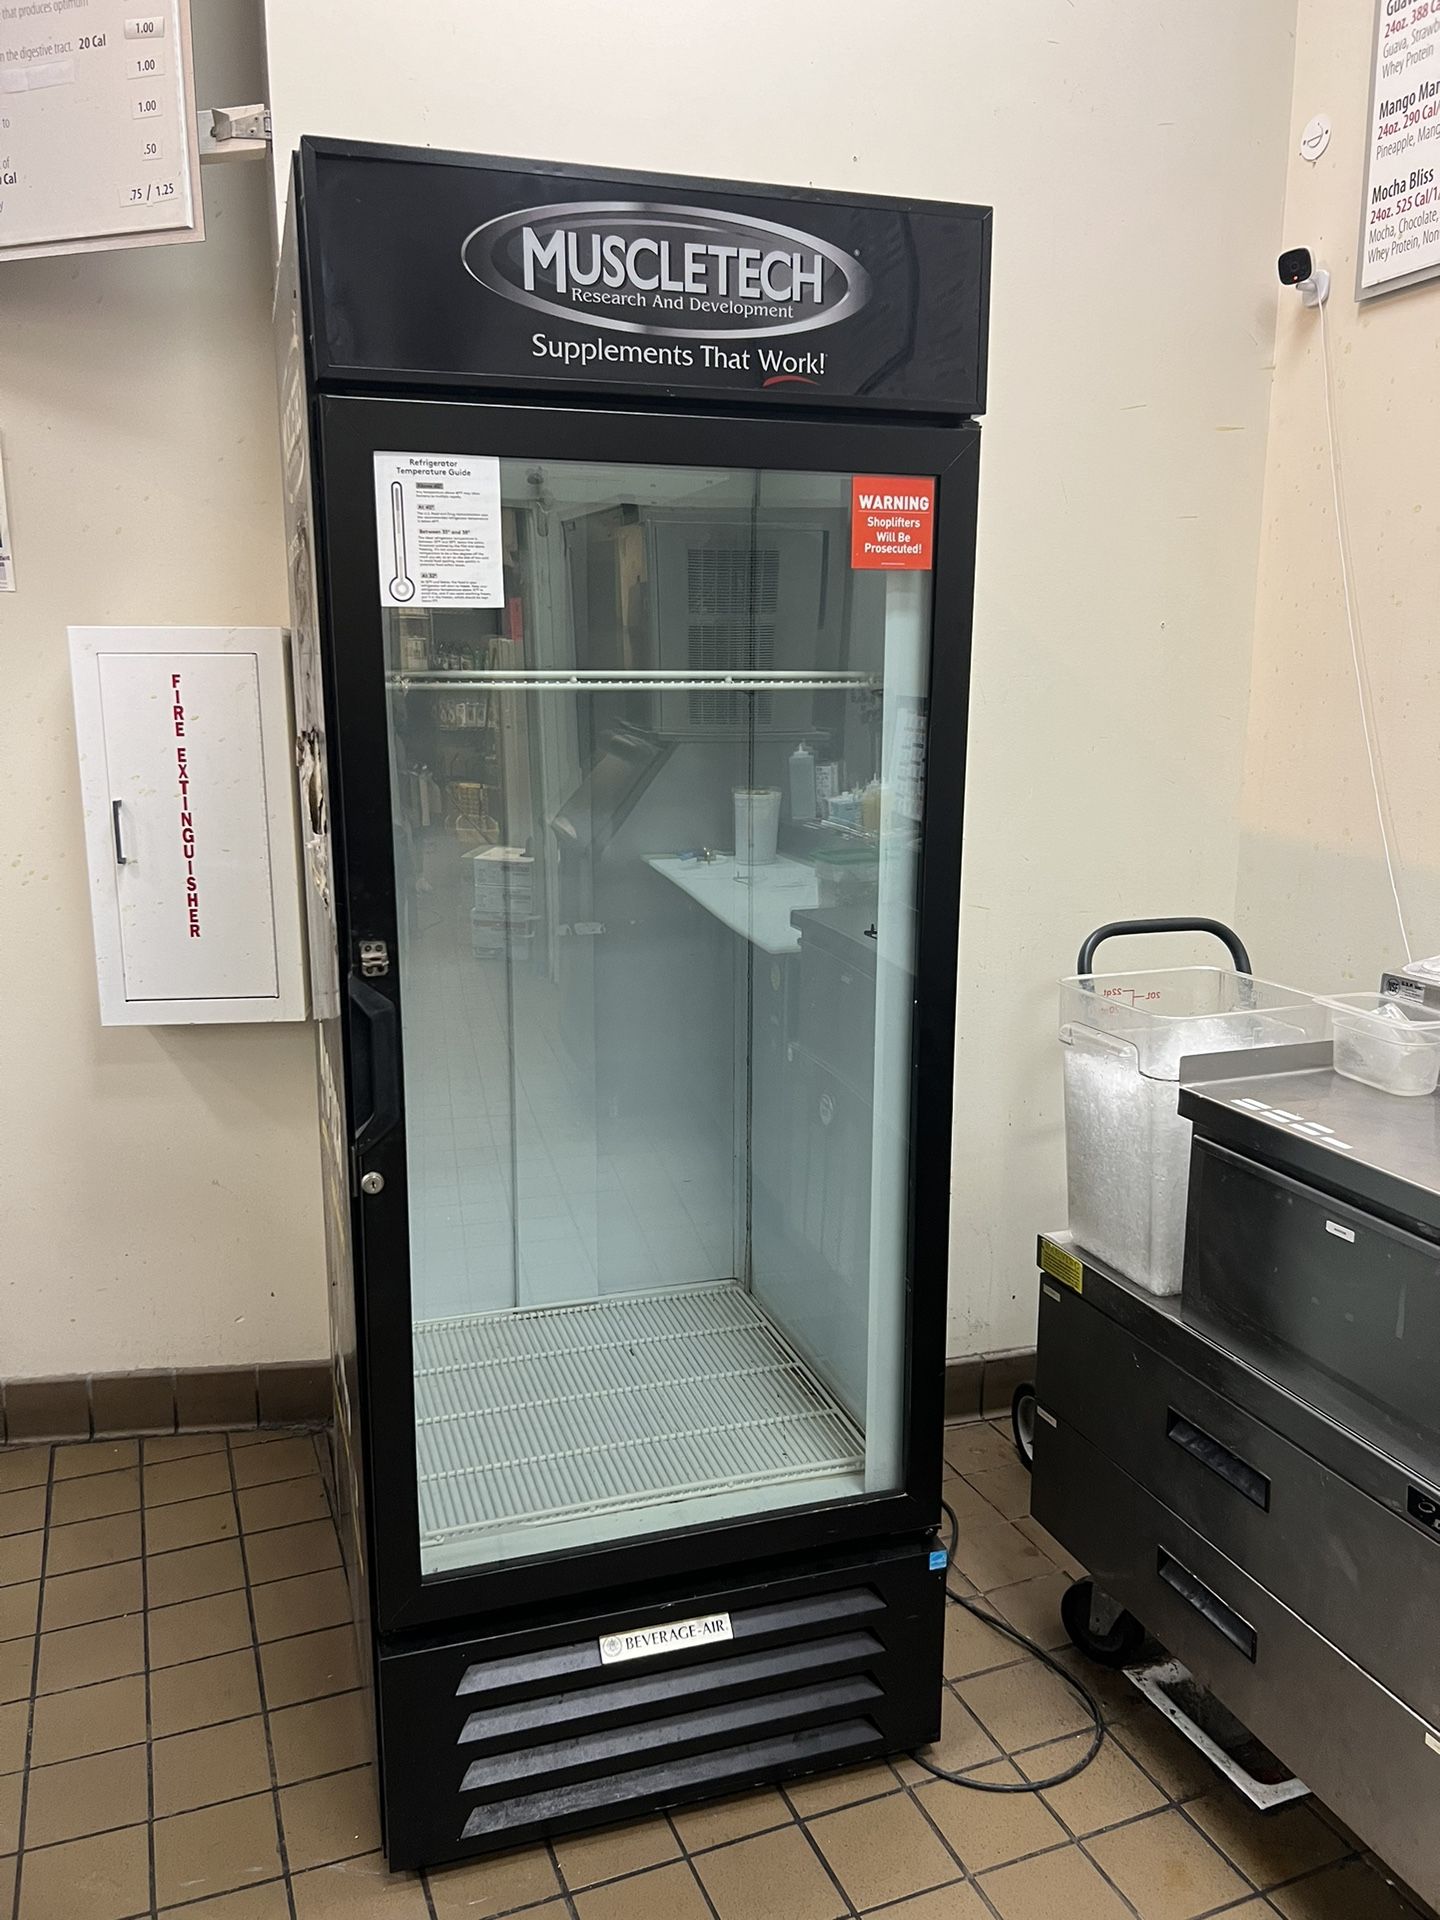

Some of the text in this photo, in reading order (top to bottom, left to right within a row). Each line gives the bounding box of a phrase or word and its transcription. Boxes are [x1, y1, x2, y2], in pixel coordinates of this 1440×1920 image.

[2, 6, 17, 20] that
[19, 3, 52, 18] produces
[1384, 18, 1408, 38] 24oz.
[1410, 3, 1429, 24] 388
[136, 22, 154, 34] 1.00
[6, 48, 18, 61] the
[20, 44, 53, 61] digestive
[78, 37, 90, 50] 20
[92, 34, 106, 47] Cal
[1383, 38, 1409, 58] Guava,
[137, 60, 155, 72] 1.00
[1382, 44, 1434, 79] Whey Protein
[138, 100, 156, 112] 1.00
[1379, 92, 1416, 120] Mango
[2, 118, 10, 128] to
[1377, 122, 1401, 140] 24oz.
[1403, 109, 1420, 129] 290
[144, 143, 157, 155] .50
[1376, 133, 1416, 160] Pineapple,
[4, 172, 16, 185] Cal
[1372, 168, 1434, 204] Mocha Bliss
[130, 183, 174, 201] .75 / 1.25
[1370, 208, 1393, 224] 24oz.
[1396, 195, 1412, 215] 525
[1369, 210, 1439, 244] Mocha, Chocolate,
[1368, 247, 1390, 264] Whey
[1391, 236, 1420, 256] Protein,
[522, 226, 824, 304] MUSCLETECH
[572, 288, 794, 319] Research And Development
[532, 332, 826, 374] Supplements That Work!
[396, 467, 446, 477] Temperature
[409, 459, 457, 469] Refrigerator
[858, 495, 929, 511] WARNING
[867, 517, 920, 529] Shoplifters
[864, 543, 922, 554] Prosecuted!
[876, 532, 911, 542] Will Be
[171, 674, 200, 938] FIRE EXTINGUISHER
[625, 1620, 725, 1650] BEVERAGE-AIR
